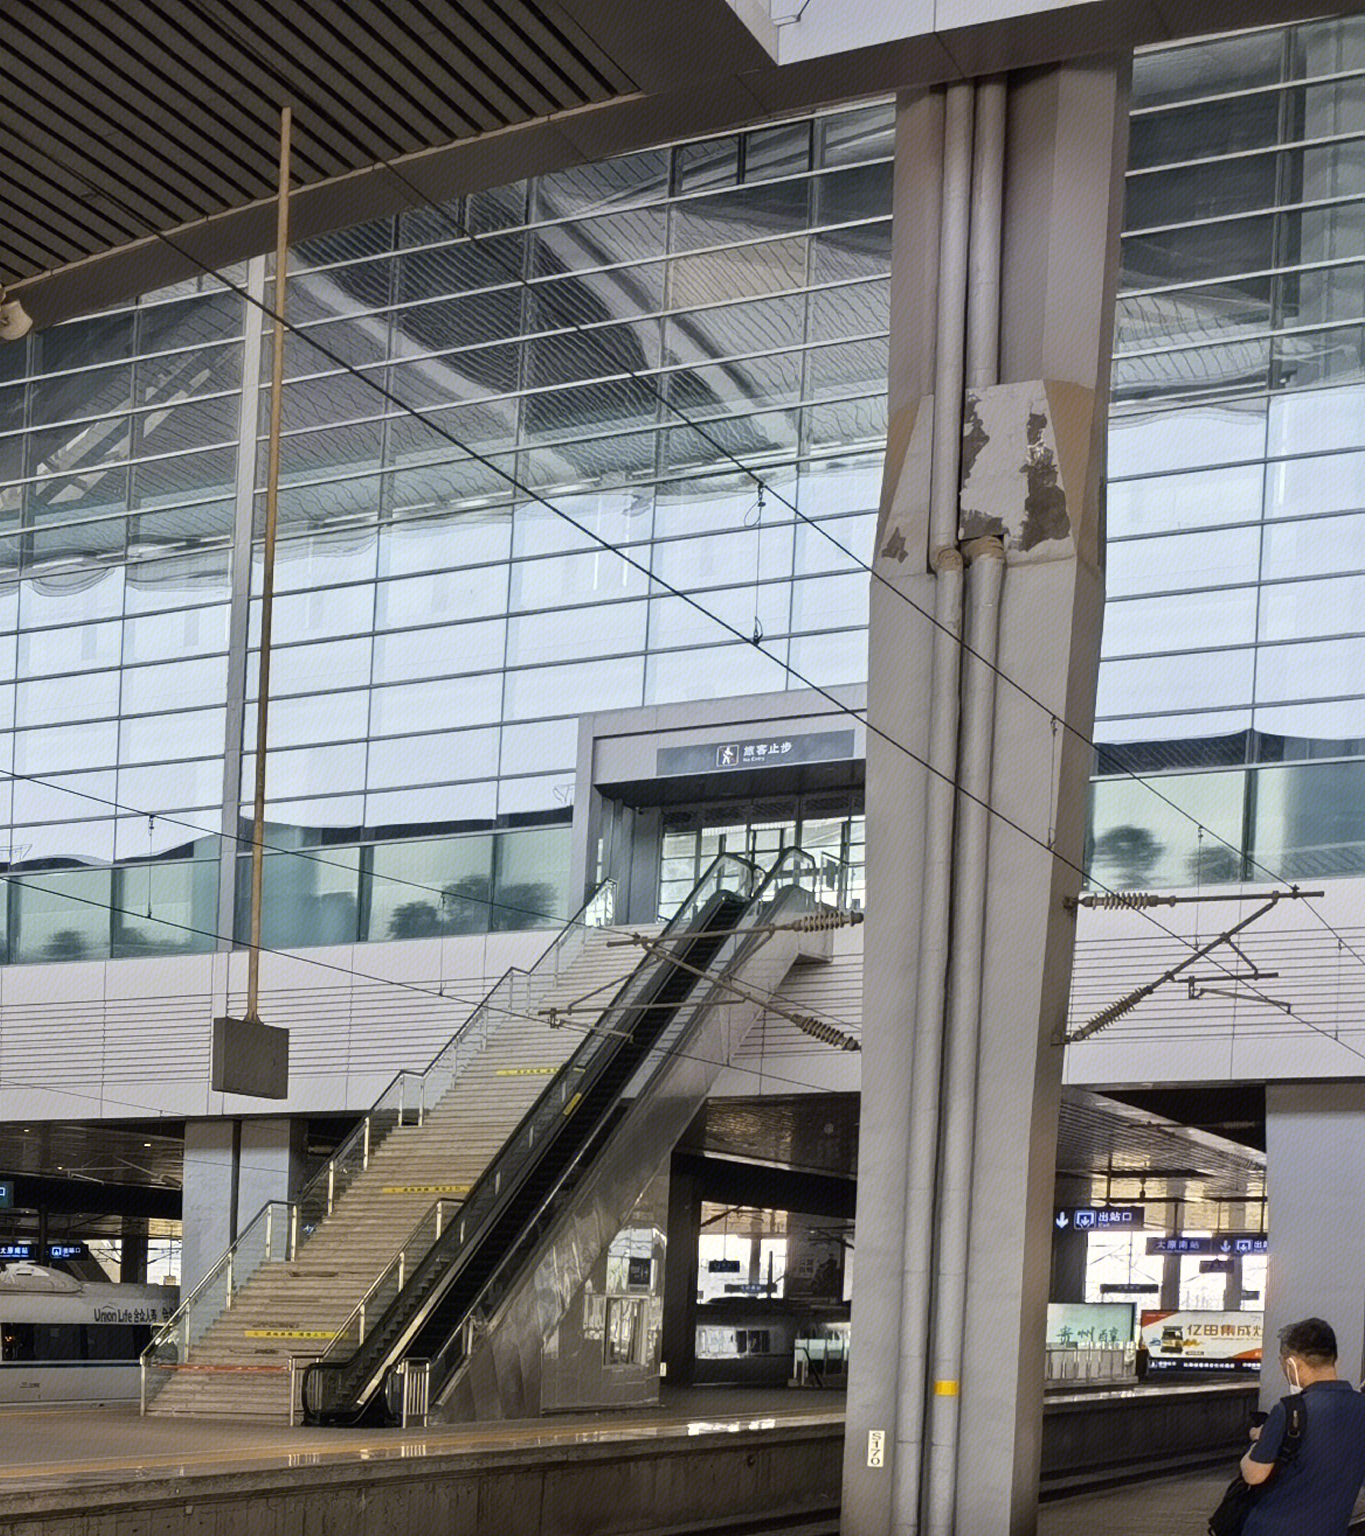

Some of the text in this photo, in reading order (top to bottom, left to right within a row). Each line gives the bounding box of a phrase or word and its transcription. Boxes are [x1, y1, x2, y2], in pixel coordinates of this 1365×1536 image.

[743, 741, 792, 756] 旅客止步
[1098, 1212, 1132, 1222] 出站口
[1156, 1241, 1200, 1249] 太原南站
[871, 1432, 882, 1465] S170
